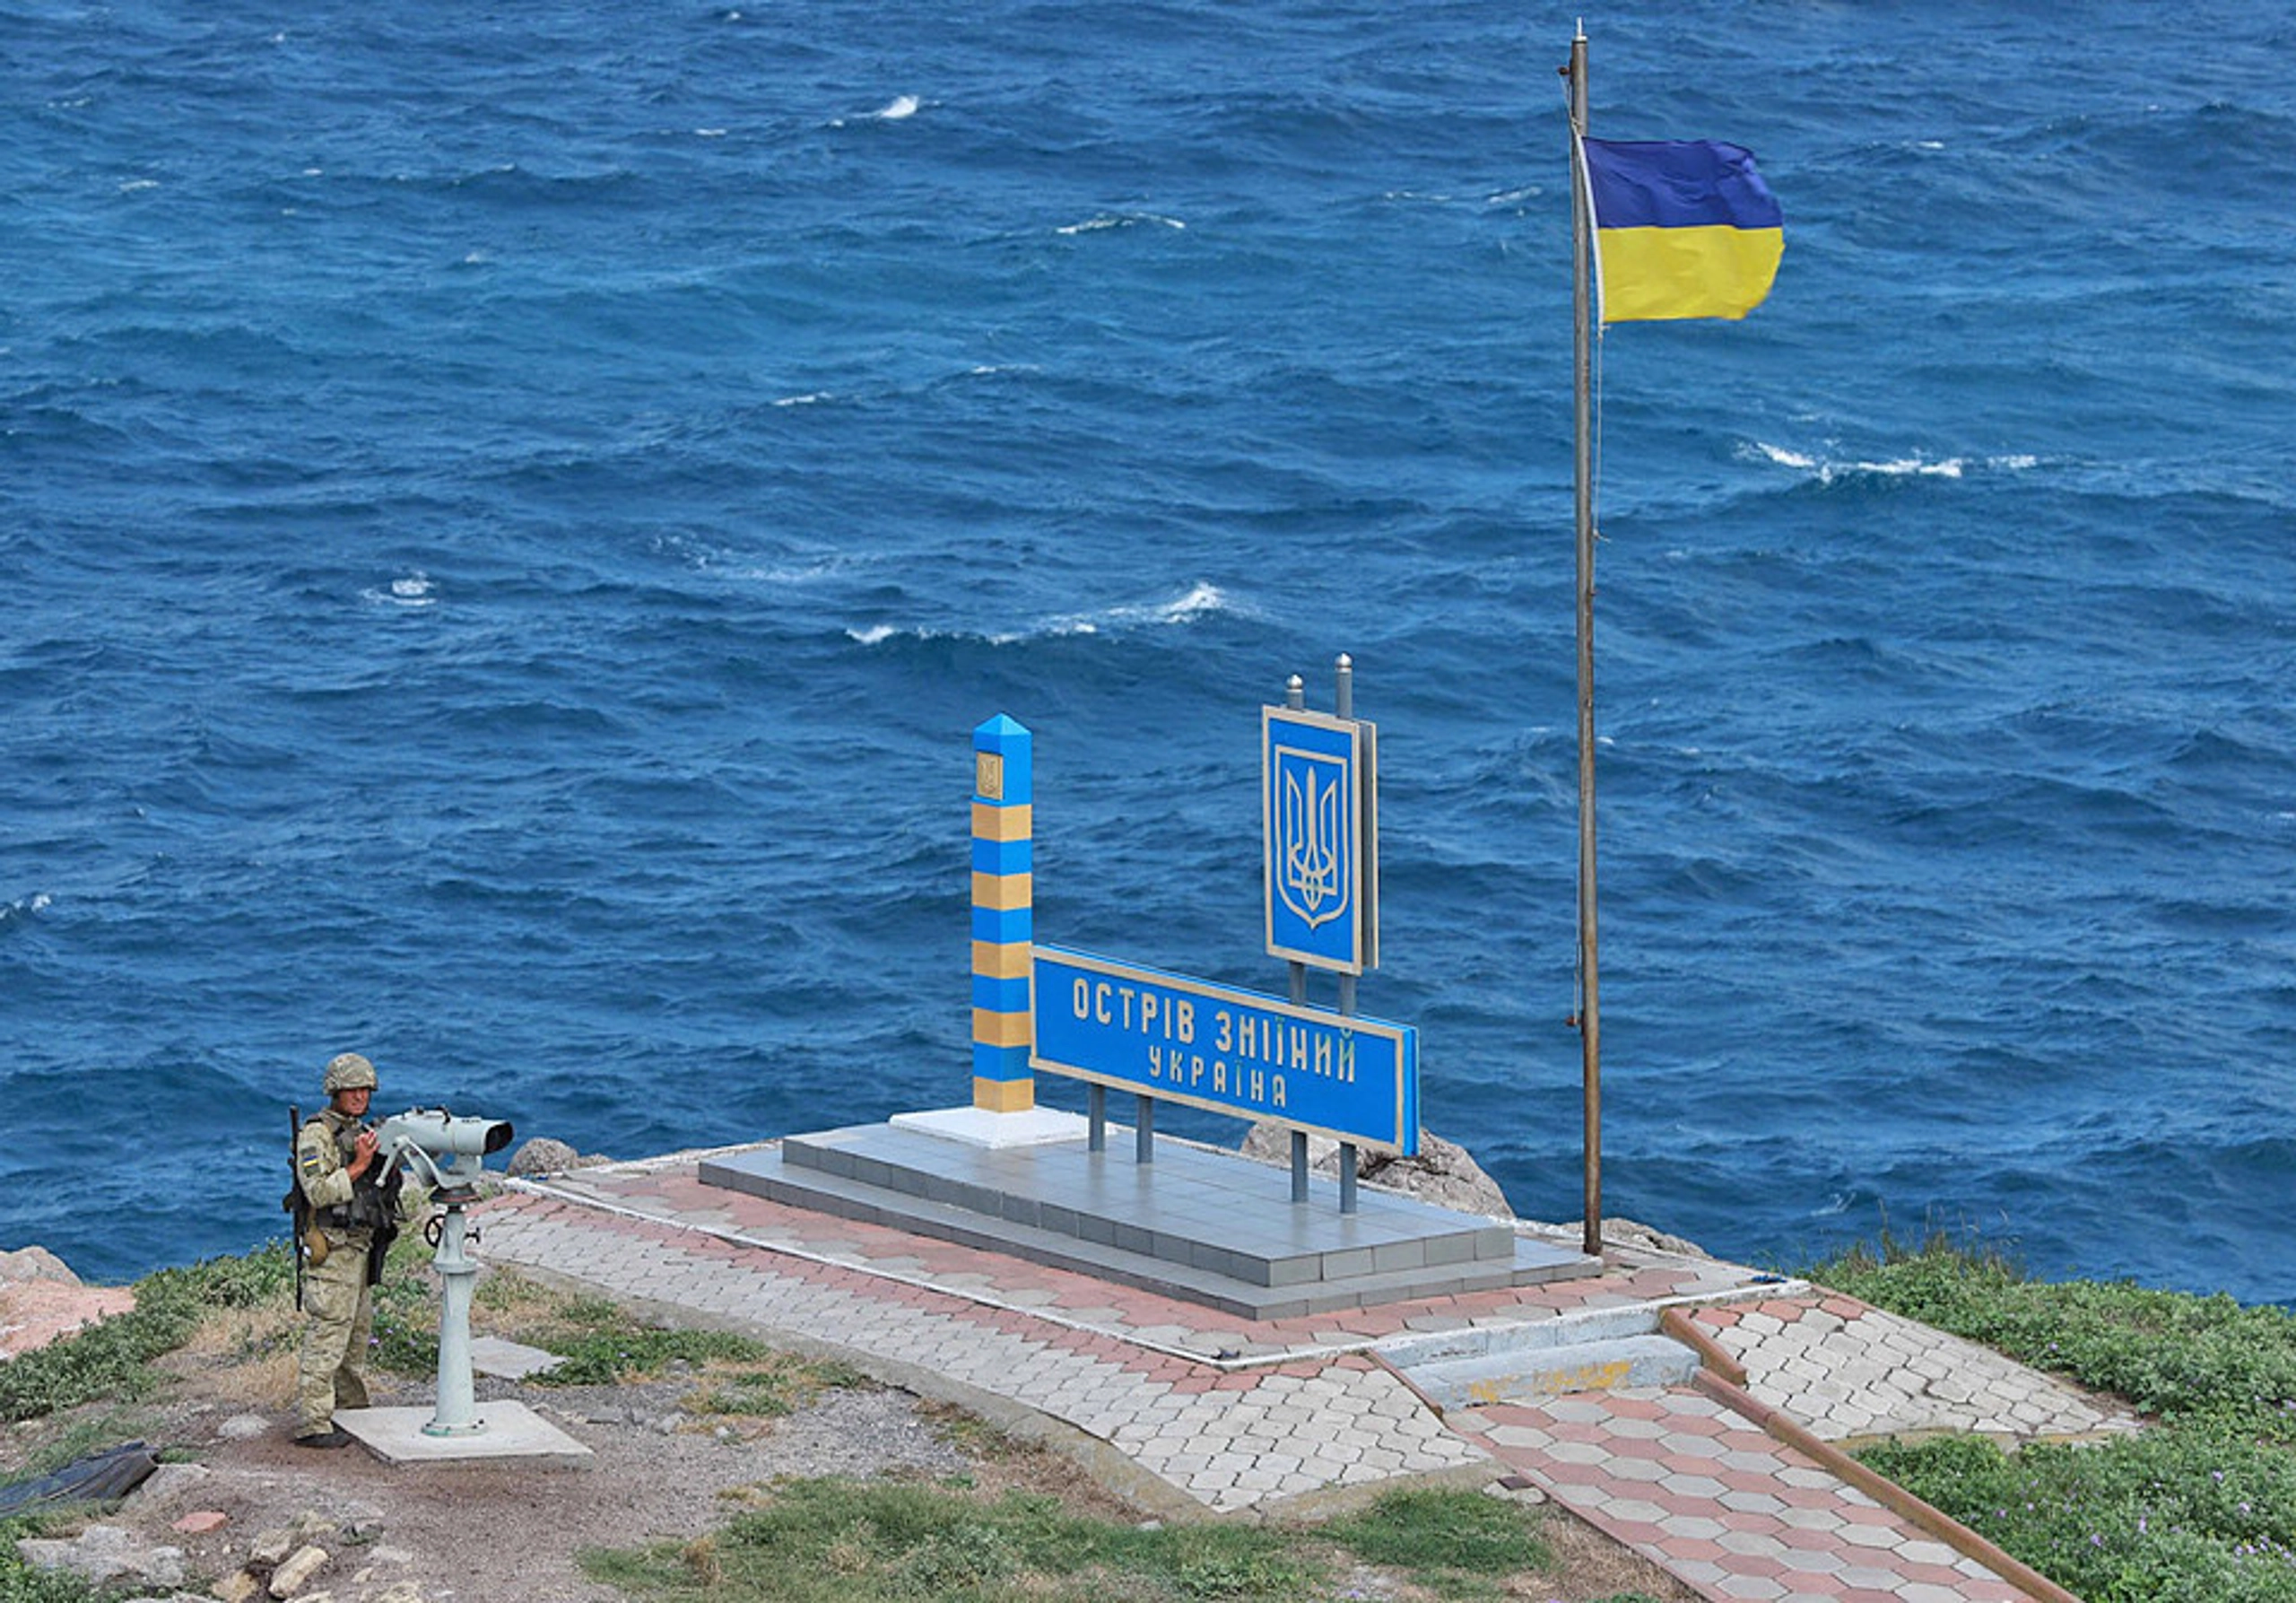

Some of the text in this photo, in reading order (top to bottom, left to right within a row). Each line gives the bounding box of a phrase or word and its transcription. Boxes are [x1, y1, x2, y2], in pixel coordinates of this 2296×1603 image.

[1073, 978, 1355, 1084] ОСТРІВ ЗМІЇНИЙ
[1148, 1046, 1287, 1108] УКРАЇНА
